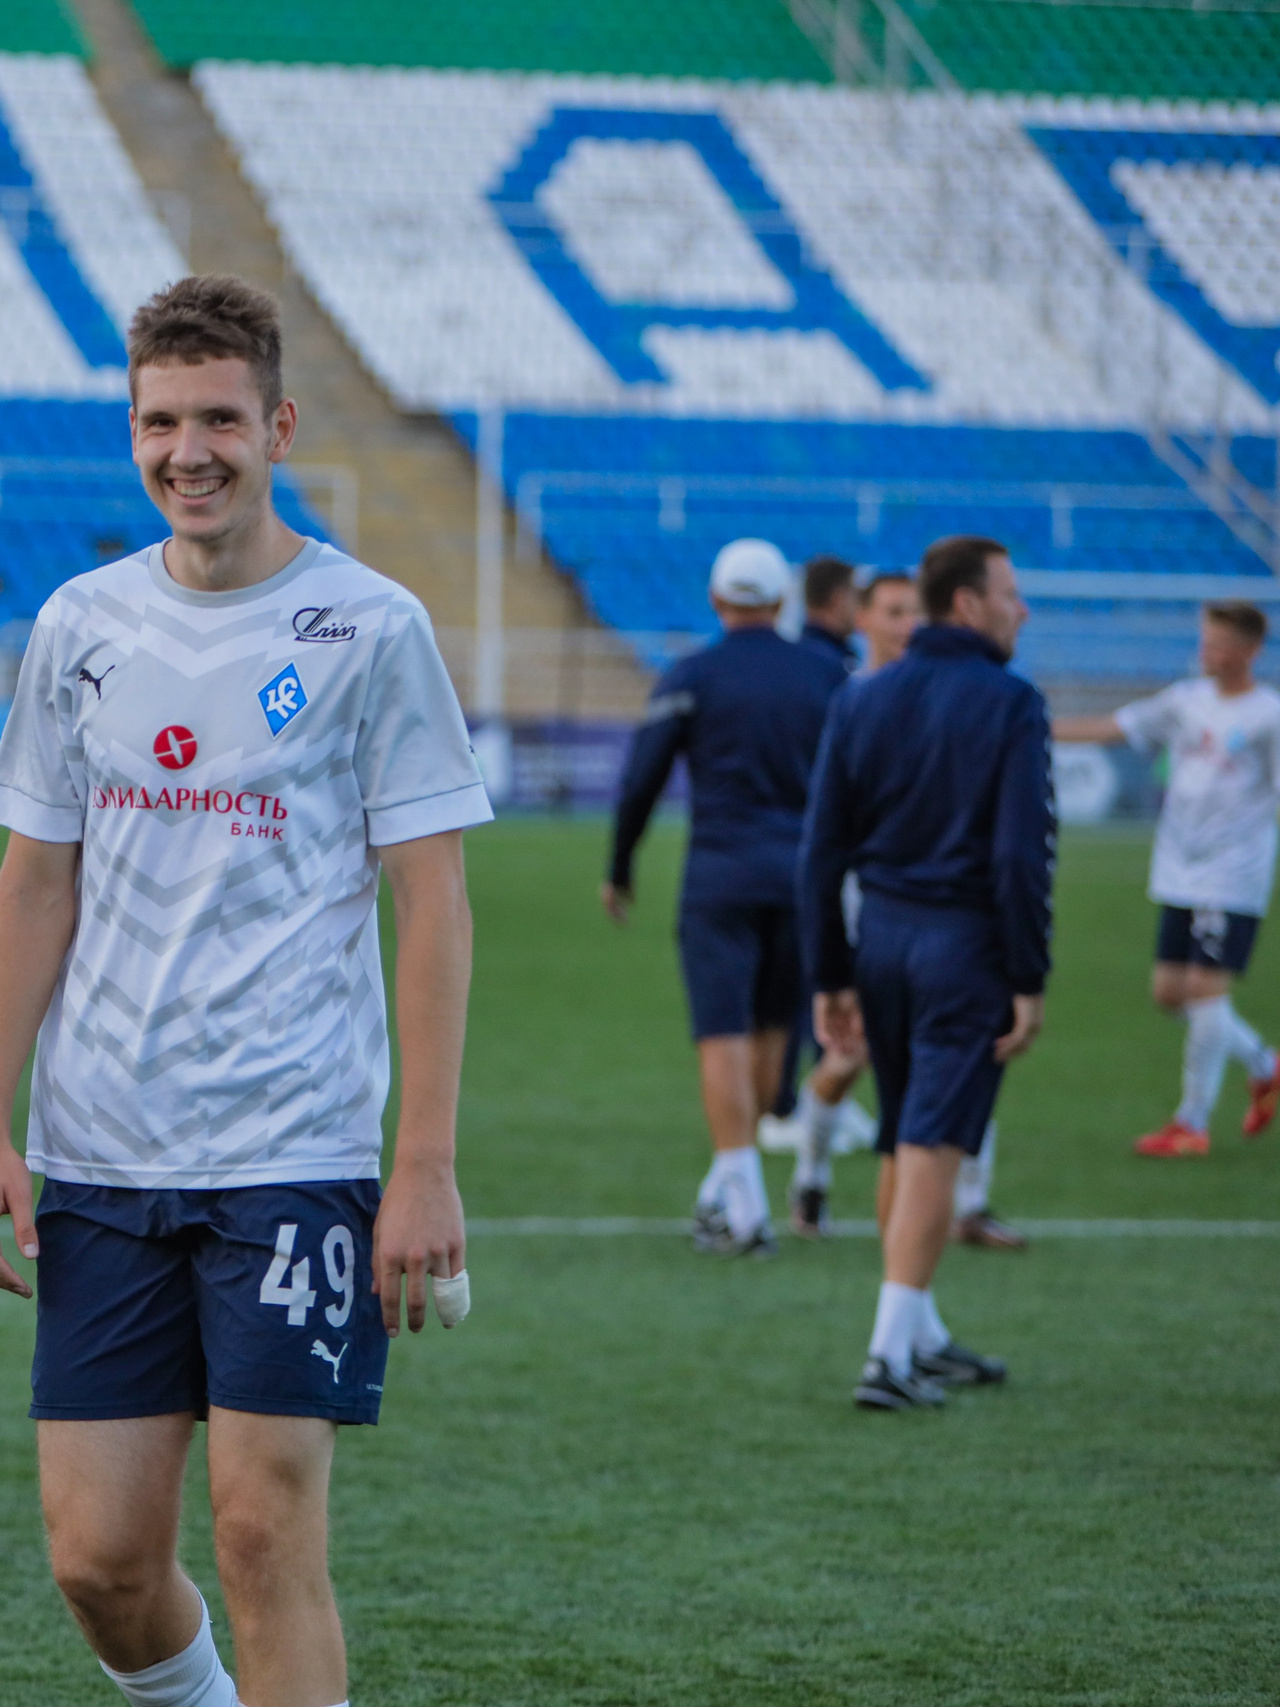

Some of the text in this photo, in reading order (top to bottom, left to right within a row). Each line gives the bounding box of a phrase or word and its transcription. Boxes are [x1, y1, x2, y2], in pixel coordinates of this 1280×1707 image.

[93, 786, 288, 820] ОЛИДАРНОСТЬ
[231, 823, 285, 842] БАНК
[259, 1223, 356, 1328] 49
